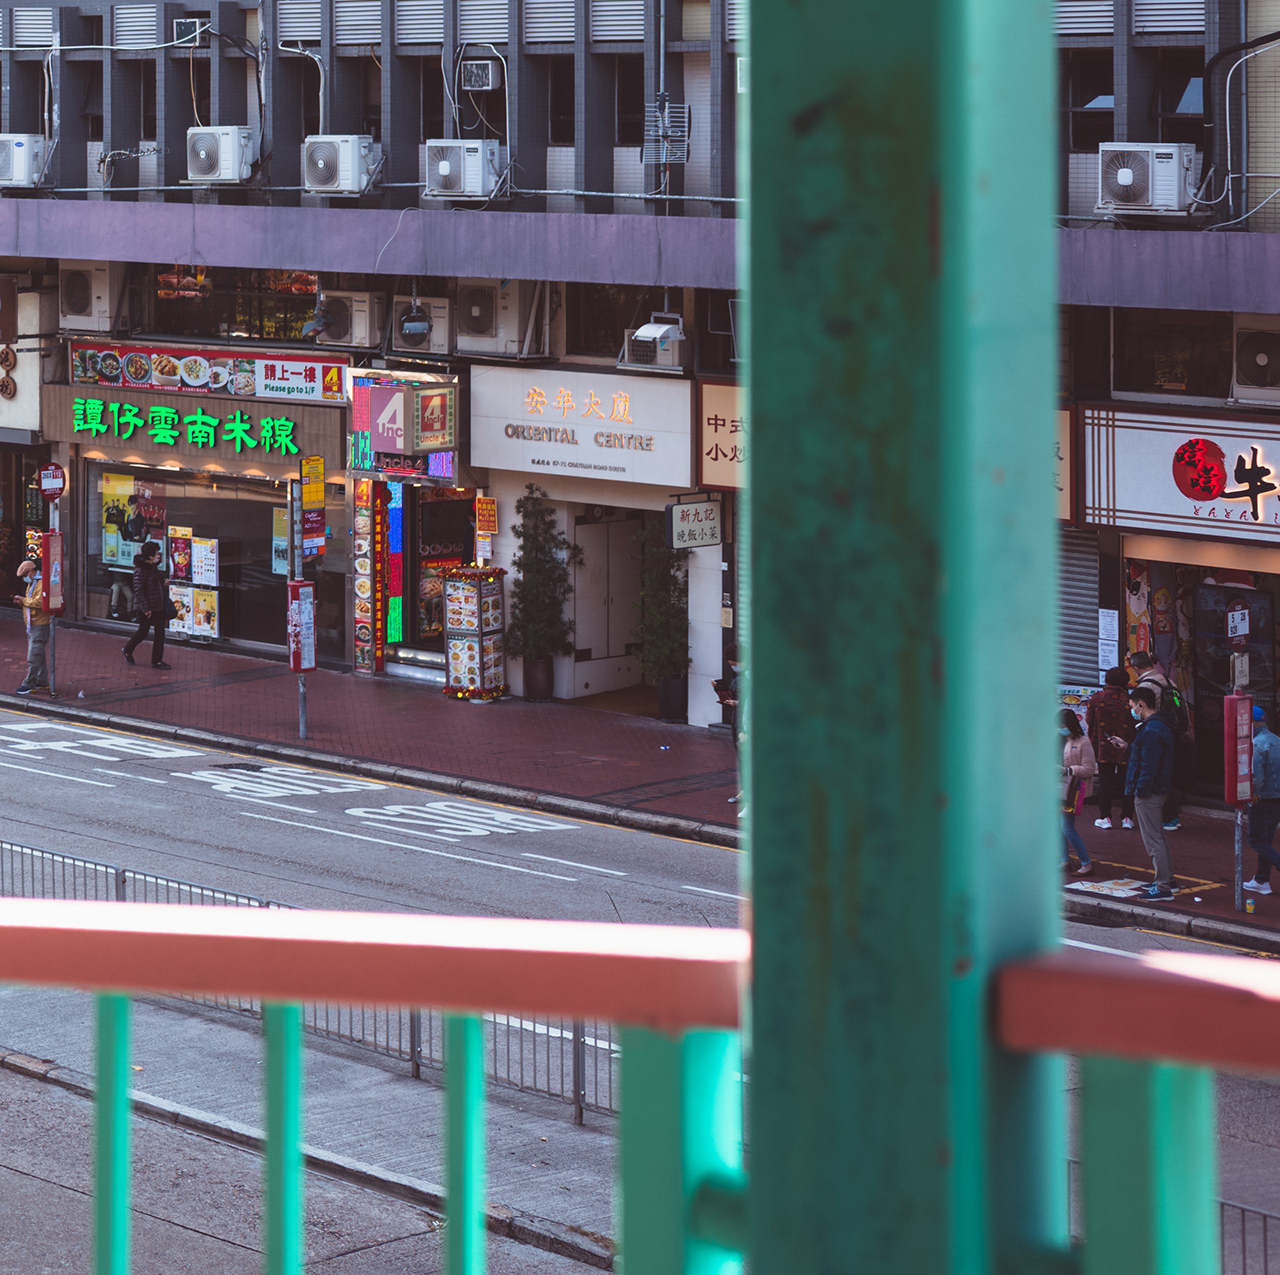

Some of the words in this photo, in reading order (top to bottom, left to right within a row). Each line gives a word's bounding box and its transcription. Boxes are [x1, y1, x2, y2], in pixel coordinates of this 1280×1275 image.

[264, 363, 316, 383] 請上一樓
[264, 384, 286, 392] Please
[287, 386, 295, 394] go
[305, 386, 315, 395] 1/F
[525, 386, 633, 423] 安年大廈
[73, 397, 299, 456] 譚仔雲南米線
[420, 434, 439, 443] Uncle
[504, 423, 579, 445] ORIENTAL
[594, 431, 654, 451] CENTRE
[374, 452, 412, 468] Uncle
[679, 508, 715, 524] 新九記
[677, 526, 718, 543] 晚飯小菜
[171, 766, 390, 797] STOP
[345, 799, 581, 837] BUS
